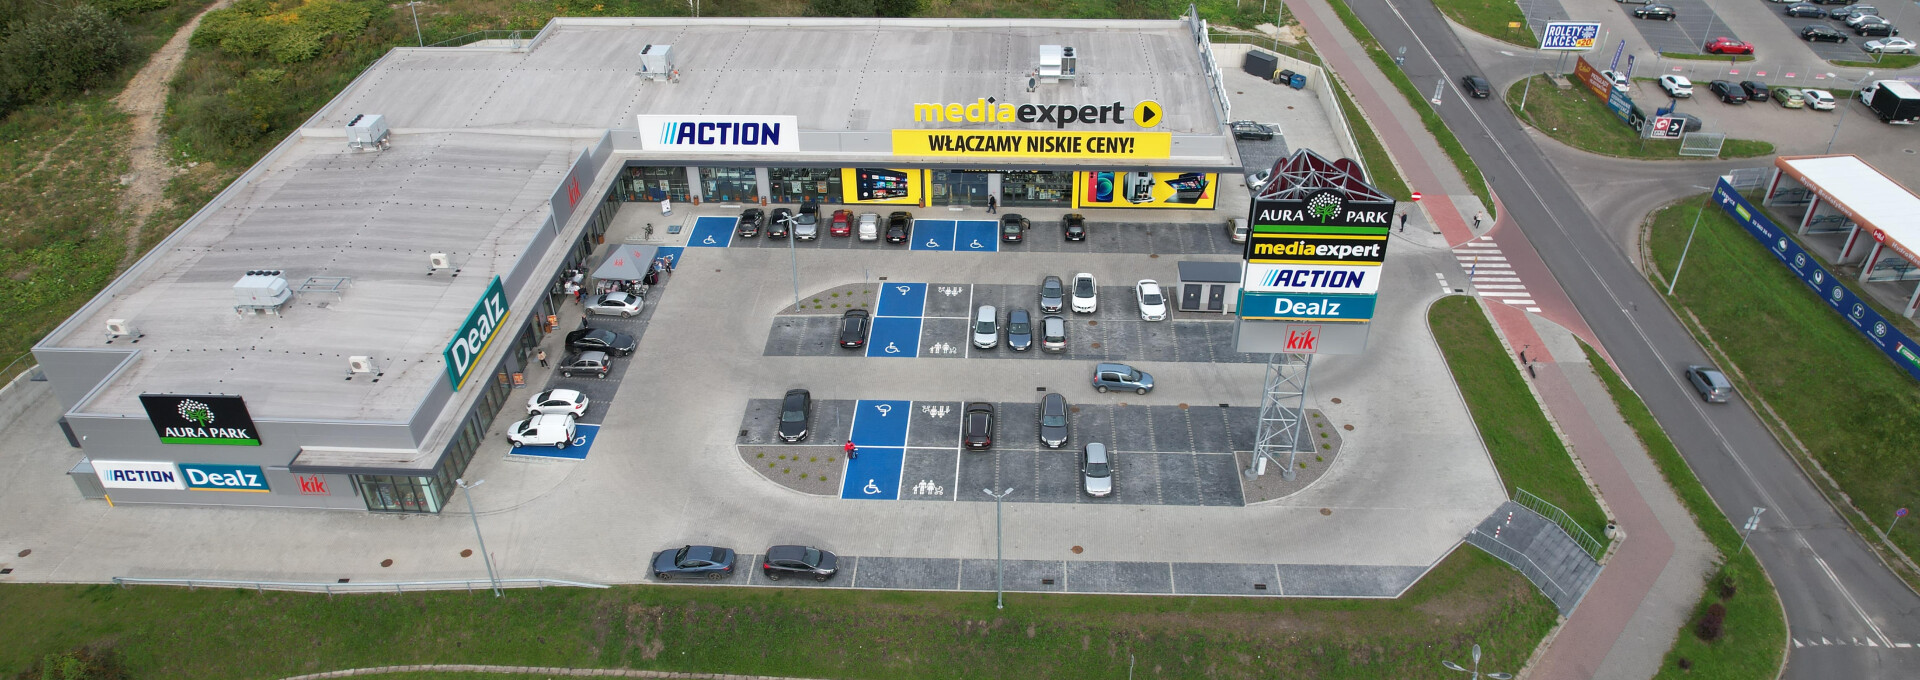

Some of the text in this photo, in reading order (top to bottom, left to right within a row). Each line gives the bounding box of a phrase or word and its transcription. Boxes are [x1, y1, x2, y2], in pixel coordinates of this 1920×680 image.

[1549, 26, 1583, 36] ROLETY
[1546, 36, 1577, 46] AKCES
[913, 97, 1125, 129] mediaexpert
[676, 122, 780, 146] ACTION
[928, 134, 1135, 154] WŁĄCZAMY NISKIE CENY!
[568, 176, 582, 208] kik
[1259, 209, 1389, 224] AURA PARK
[1254, 241, 1381, 259] mediaexpert
[1273, 269, 1365, 288] ACTION
[1274, 298, 1341, 316] Dealz
[452, 292, 504, 377] Dealz
[1287, 328, 1316, 349] kik
[165, 426, 250, 439] AURA PARK
[114, 468, 175, 483] ACTION
[185, 468, 262, 487] Dealz
[300, 474, 326, 495] kik
